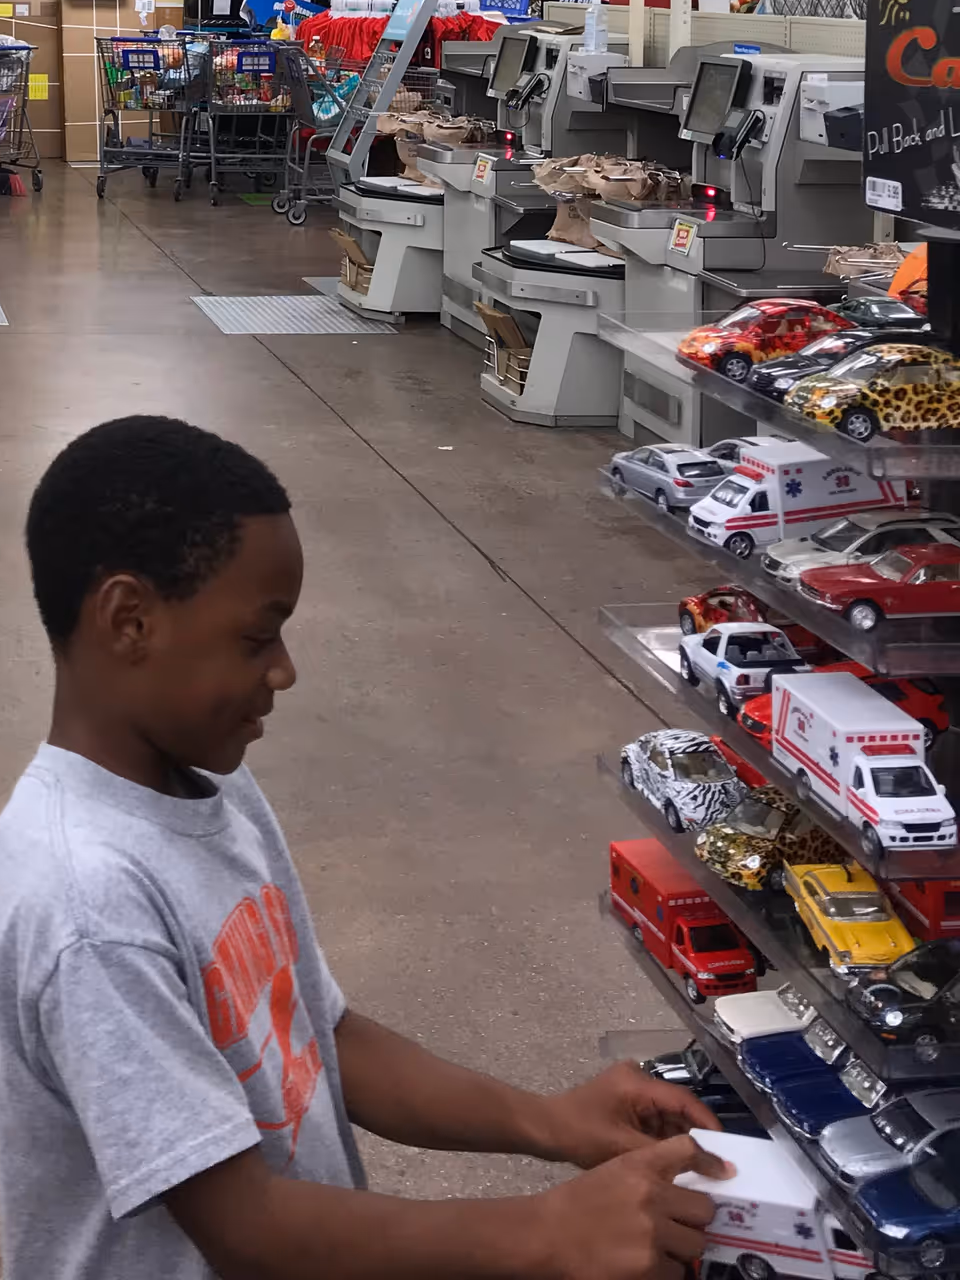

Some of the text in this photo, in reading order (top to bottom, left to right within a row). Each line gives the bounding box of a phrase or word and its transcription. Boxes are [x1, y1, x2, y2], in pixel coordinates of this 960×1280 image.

[886, 26, 960, 89] Ca
[868, 106, 960, 160] Pull Back and L
